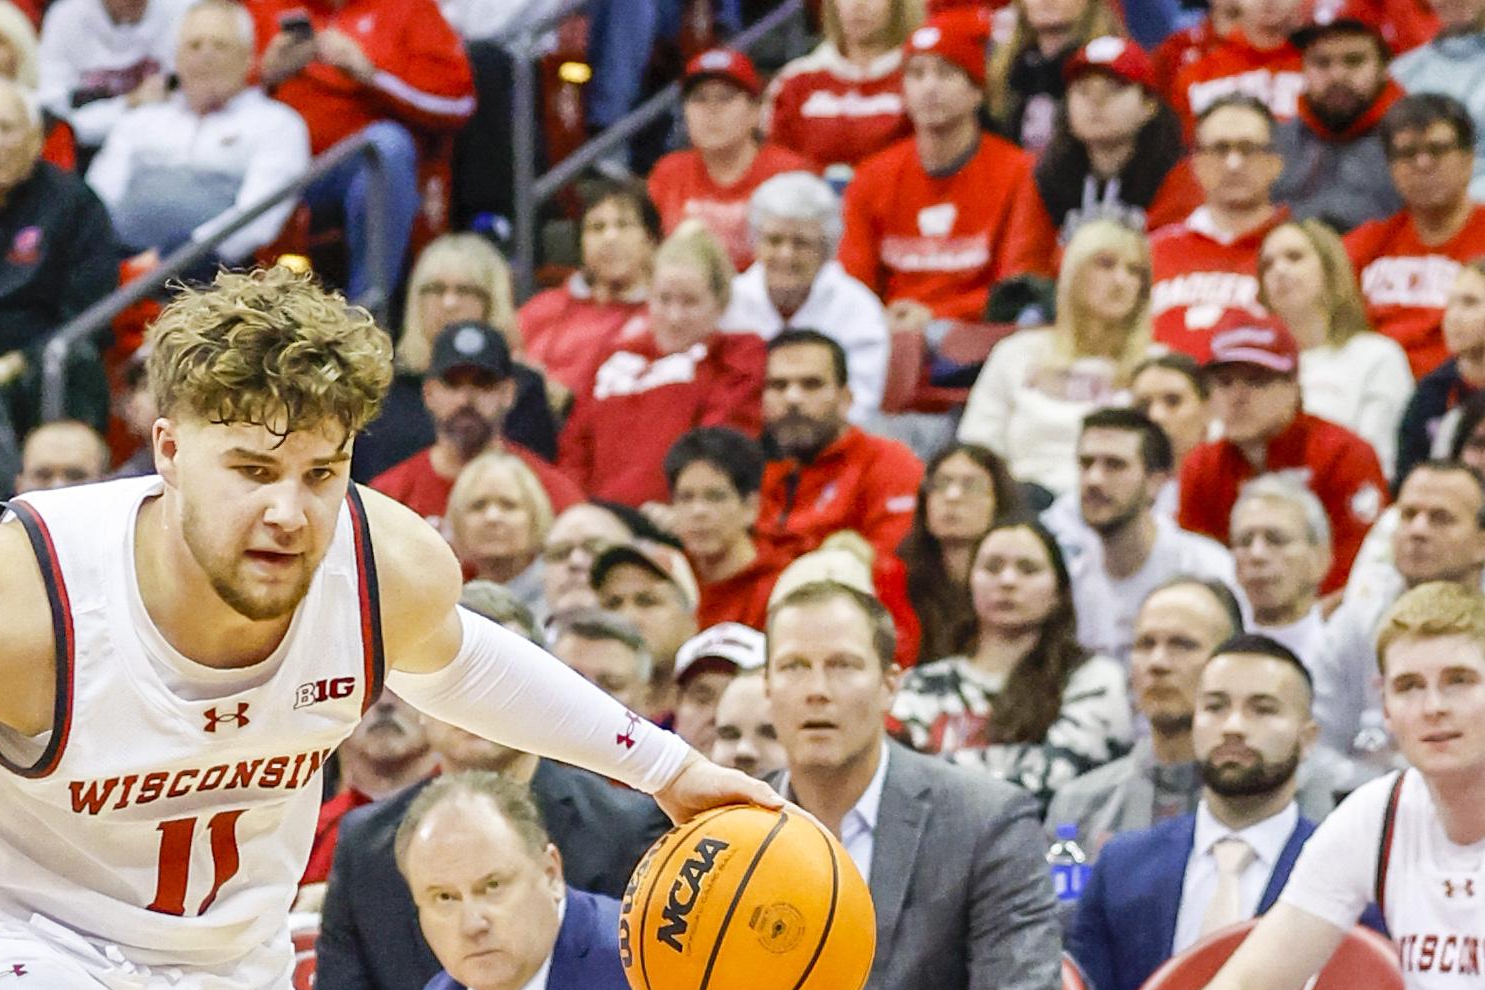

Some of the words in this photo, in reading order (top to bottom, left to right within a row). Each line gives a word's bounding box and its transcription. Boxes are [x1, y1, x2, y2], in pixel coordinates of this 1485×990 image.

[293, 676, 356, 710] BIG
[68, 747, 332, 815] WISCONSIN
[146, 809, 251, 917] 11
[656, 838, 730, 953] NCAA
